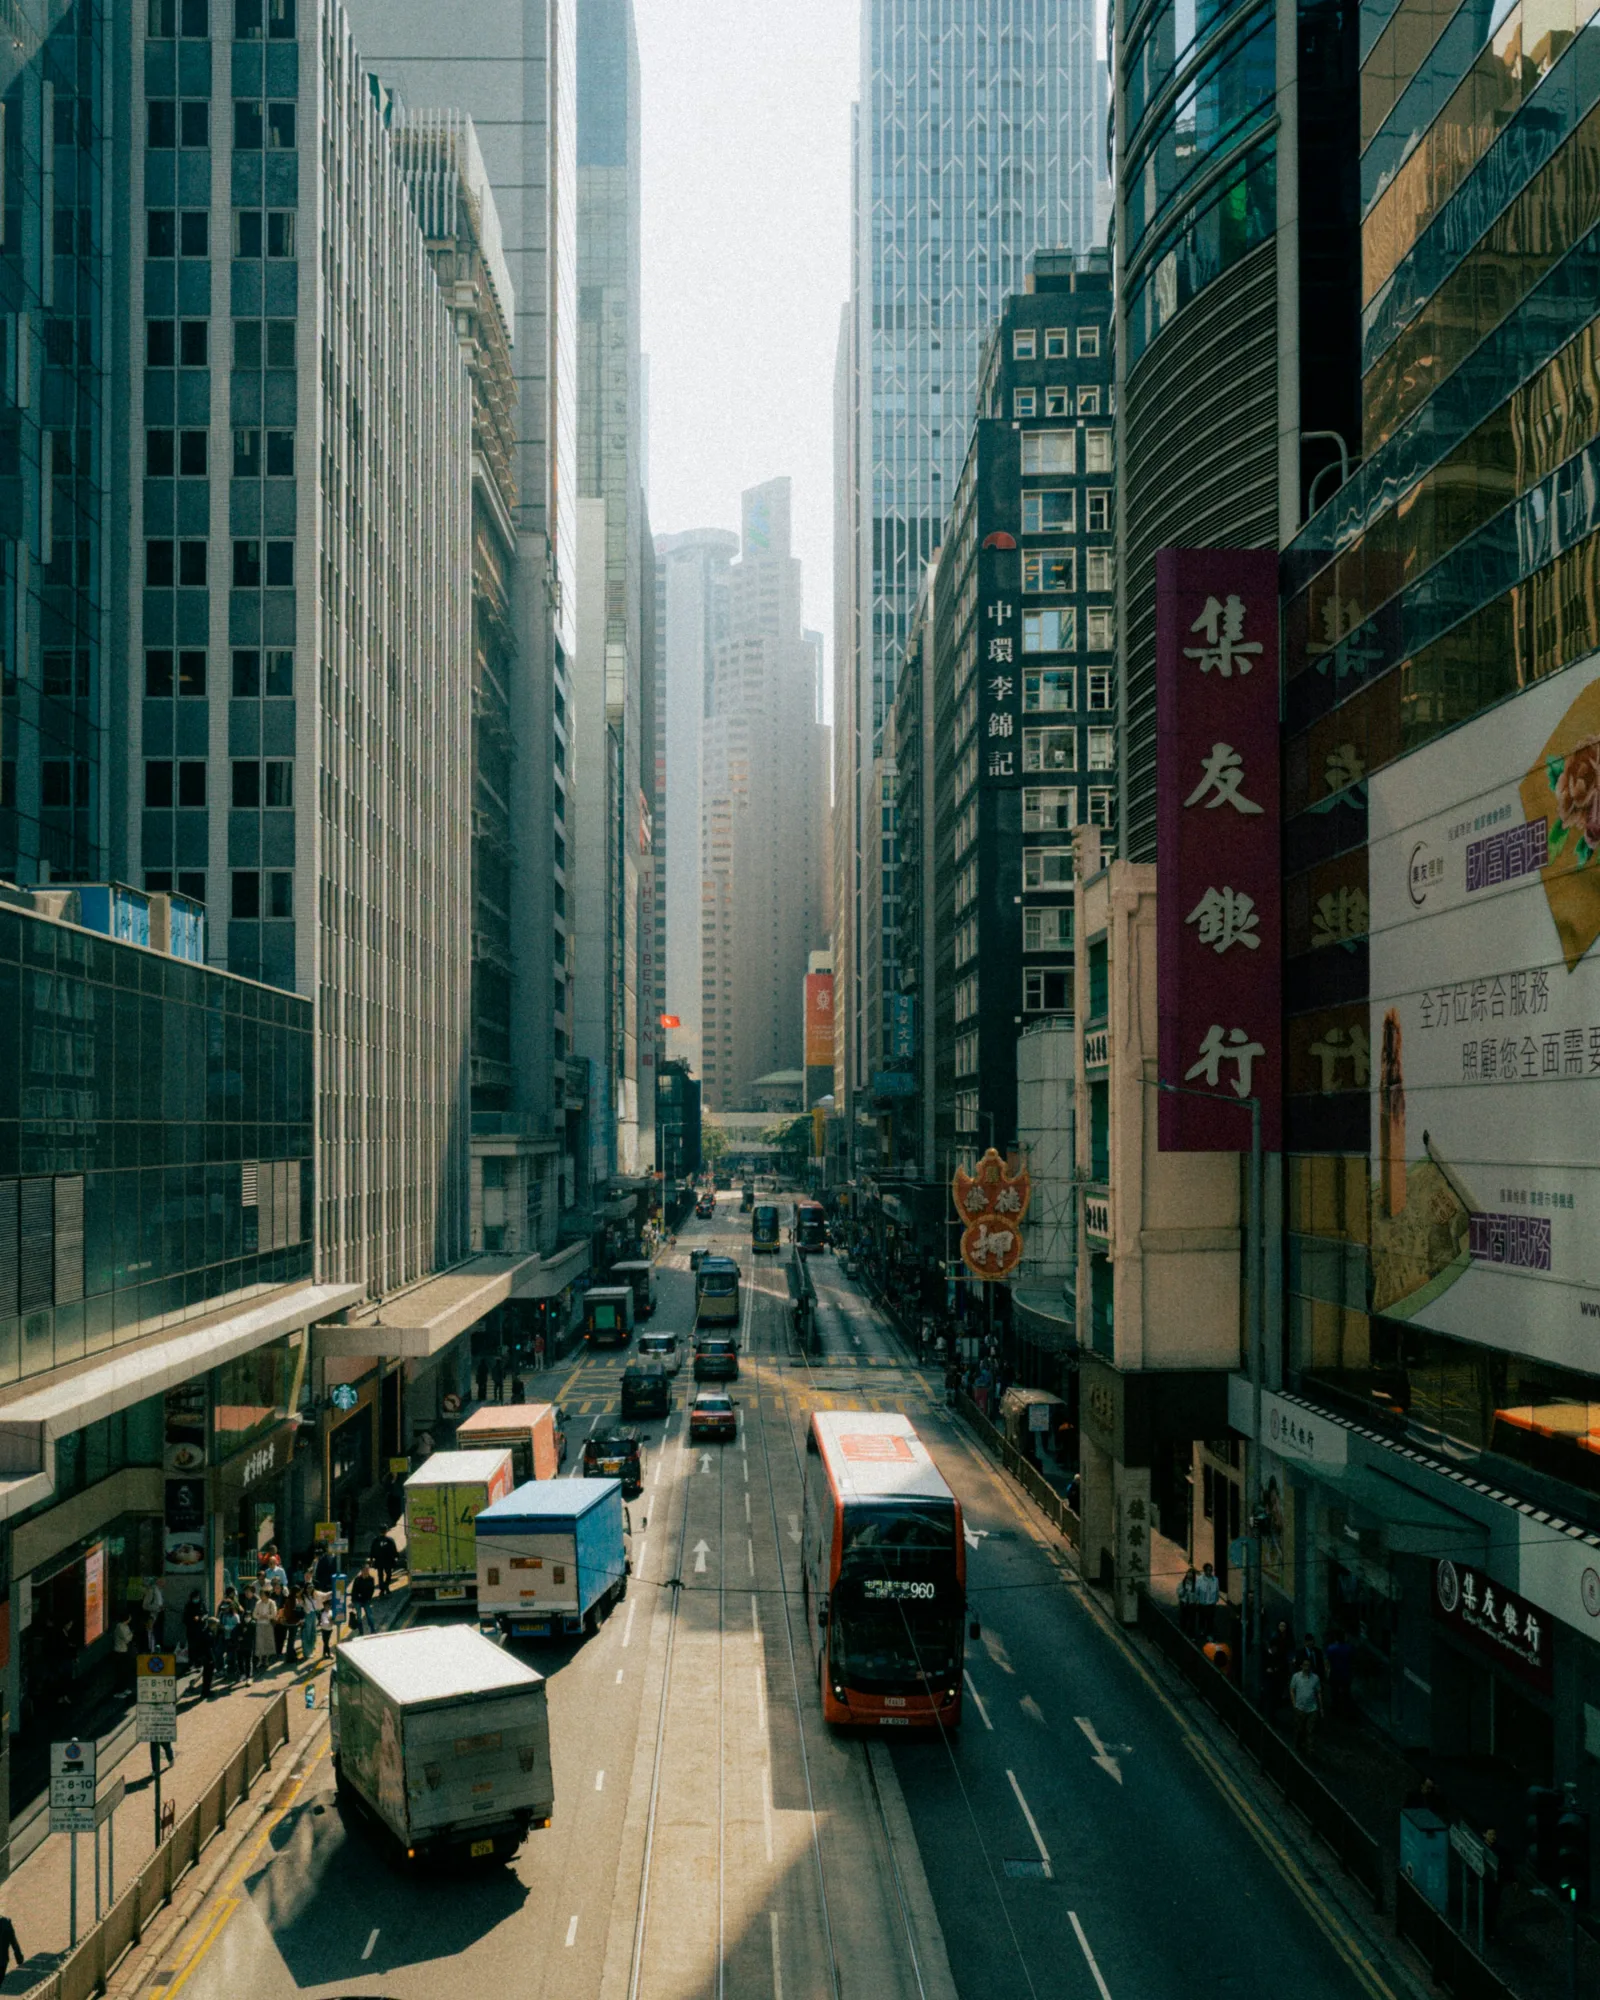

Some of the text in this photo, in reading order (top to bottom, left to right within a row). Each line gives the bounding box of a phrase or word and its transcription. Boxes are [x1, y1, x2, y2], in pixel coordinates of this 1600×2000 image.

[987, 600, 1014, 776] 中環李錦記
[1183, 594, 1265, 1098] 集友銀行
[1467, 818, 1547, 890] 財富管理
[642, 871, 652, 1042] THE SIBERIAN
[1420, 969, 1549, 1030] 全方位綜合服務
[1462, 1026, 1600, 1080] 照顧您全面需要
[971, 1224, 1014, 1268] 押
[1470, 1216, 1551, 1270] 工商服務
[1281, 1416, 1314, 1451] 集友銀行
[910, 1581, 935, 1599] 960
[1461, 1571, 1542, 1652] 集友銀行
[151, 1678, 174, 1688] 8-10
[67, 1780, 93, 1790] 8-10
[67, 1793, 87, 1802] 4-7
